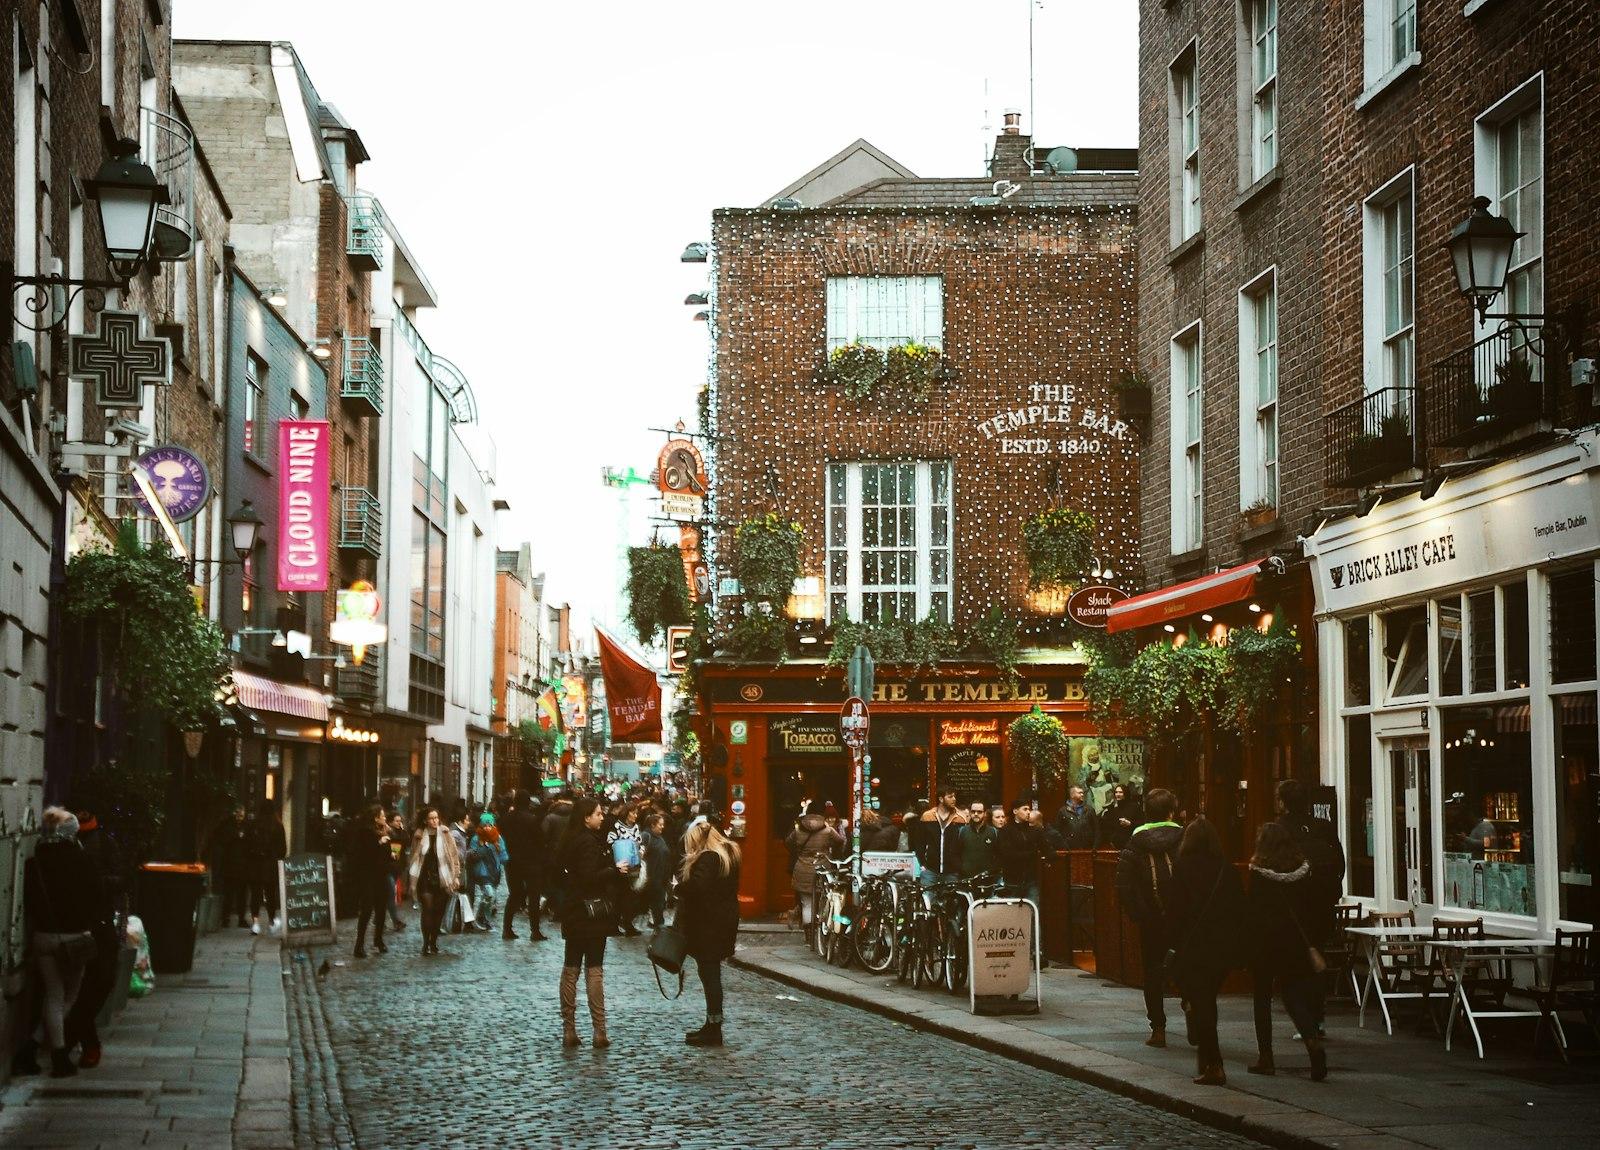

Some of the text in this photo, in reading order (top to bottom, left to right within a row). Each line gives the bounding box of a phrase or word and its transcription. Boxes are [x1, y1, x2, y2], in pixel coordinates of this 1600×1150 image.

[1028, 384, 1076, 402] THE
[976, 405, 1128, 440] TEMPLE BAR
[1060, 439, 1100, 454] 1840
[289, 427, 320, 483] NINE
[288, 490, 318, 567] CLOUD
[1534, 515, 1588, 538] Temple Bar, Dublin
[1347, 526, 1456, 586] BRICK ALLEY CAFÉ
[1087, 592, 1112, 606] Shack
[743, 687, 758, 697] 48
[921, 683, 1048, 701] TEMPLE
[625, 697, 643, 705] THE
[625, 712, 646, 723] BAR
[941, 720, 997, 733] Traditional
[779, 730, 837, 749] TOBACCO
[940, 733, 999, 745] Irish Music
[950, 750, 975, 762] TEMPLE
[1115, 754, 1142, 765] BAR
[977, 928, 1025, 941] ARIOSA
